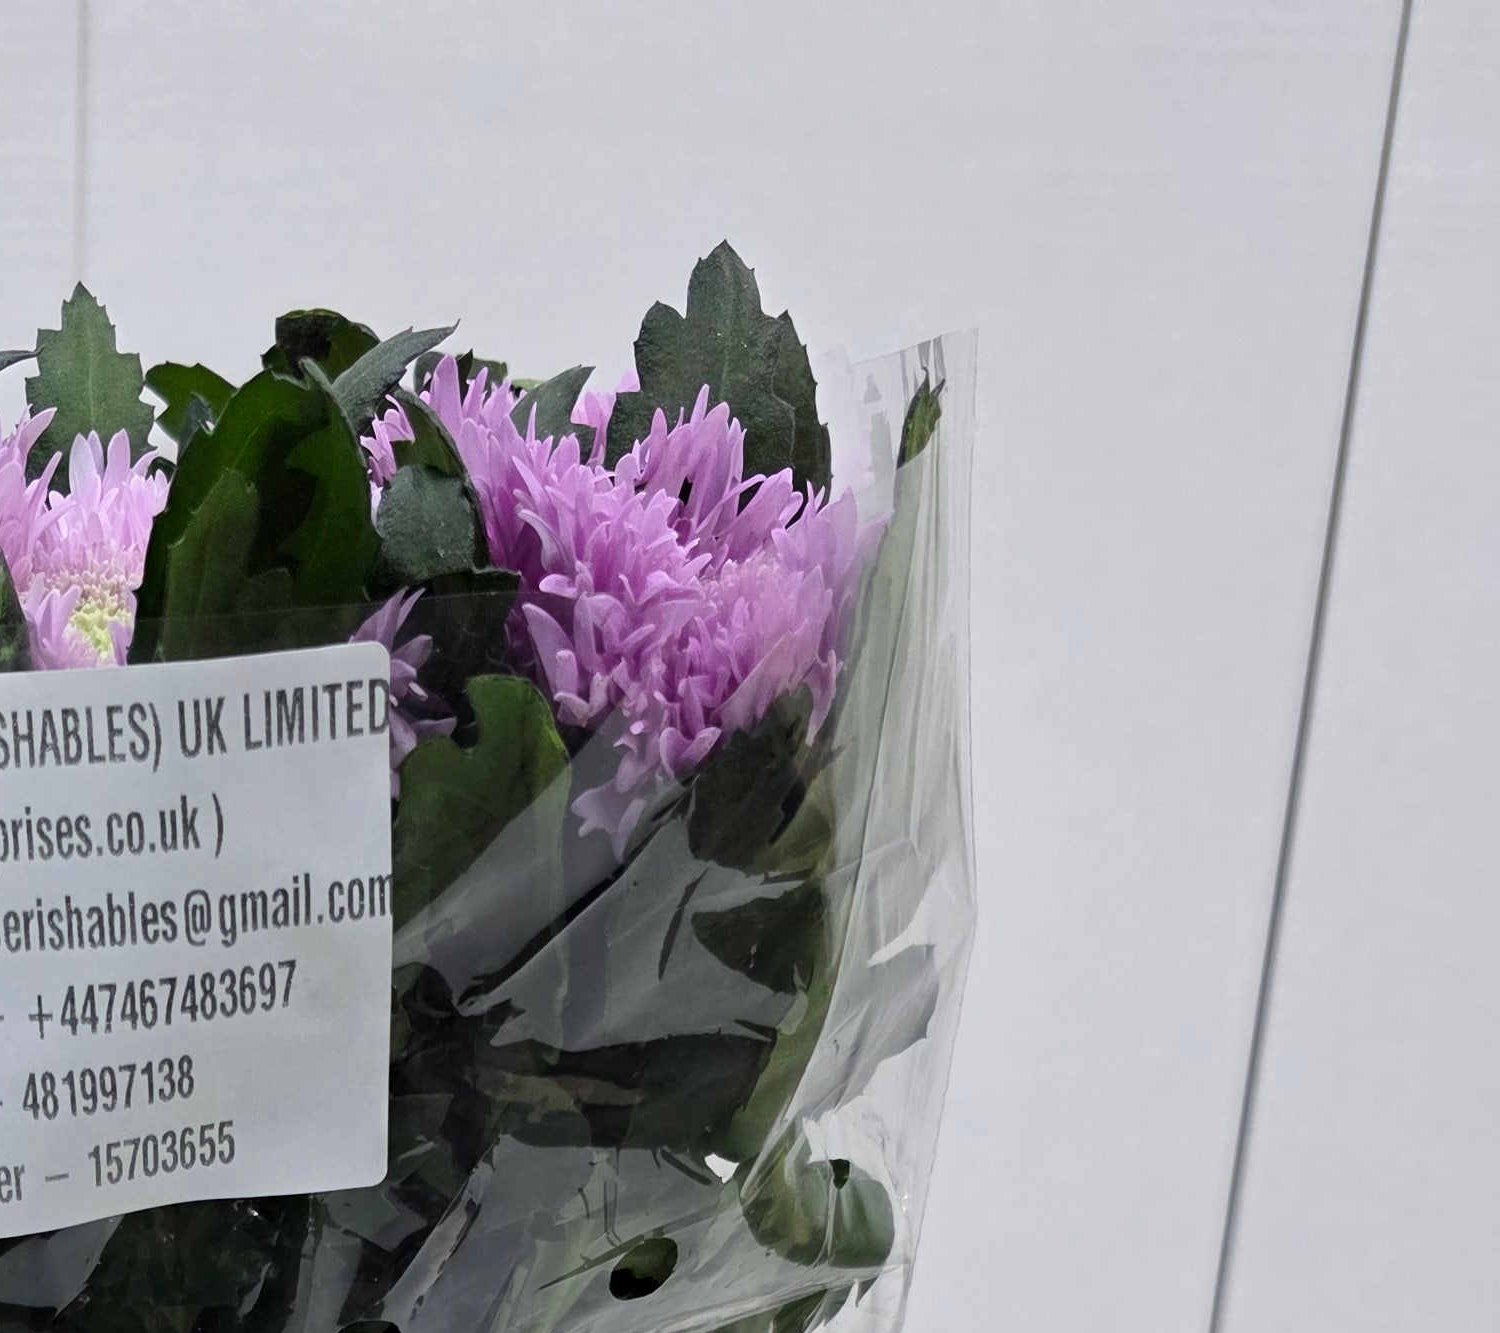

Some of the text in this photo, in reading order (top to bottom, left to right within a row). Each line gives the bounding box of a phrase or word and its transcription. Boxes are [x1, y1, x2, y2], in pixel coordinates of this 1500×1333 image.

[177, 696, 228, 759] UK
[243, 677, 390, 752] LIMITED
[27, 959, 297, 1040] +447467483697
[22, 1054, 195, 1121] 481997138
[87, 1120, 236, 1188] 15703655
